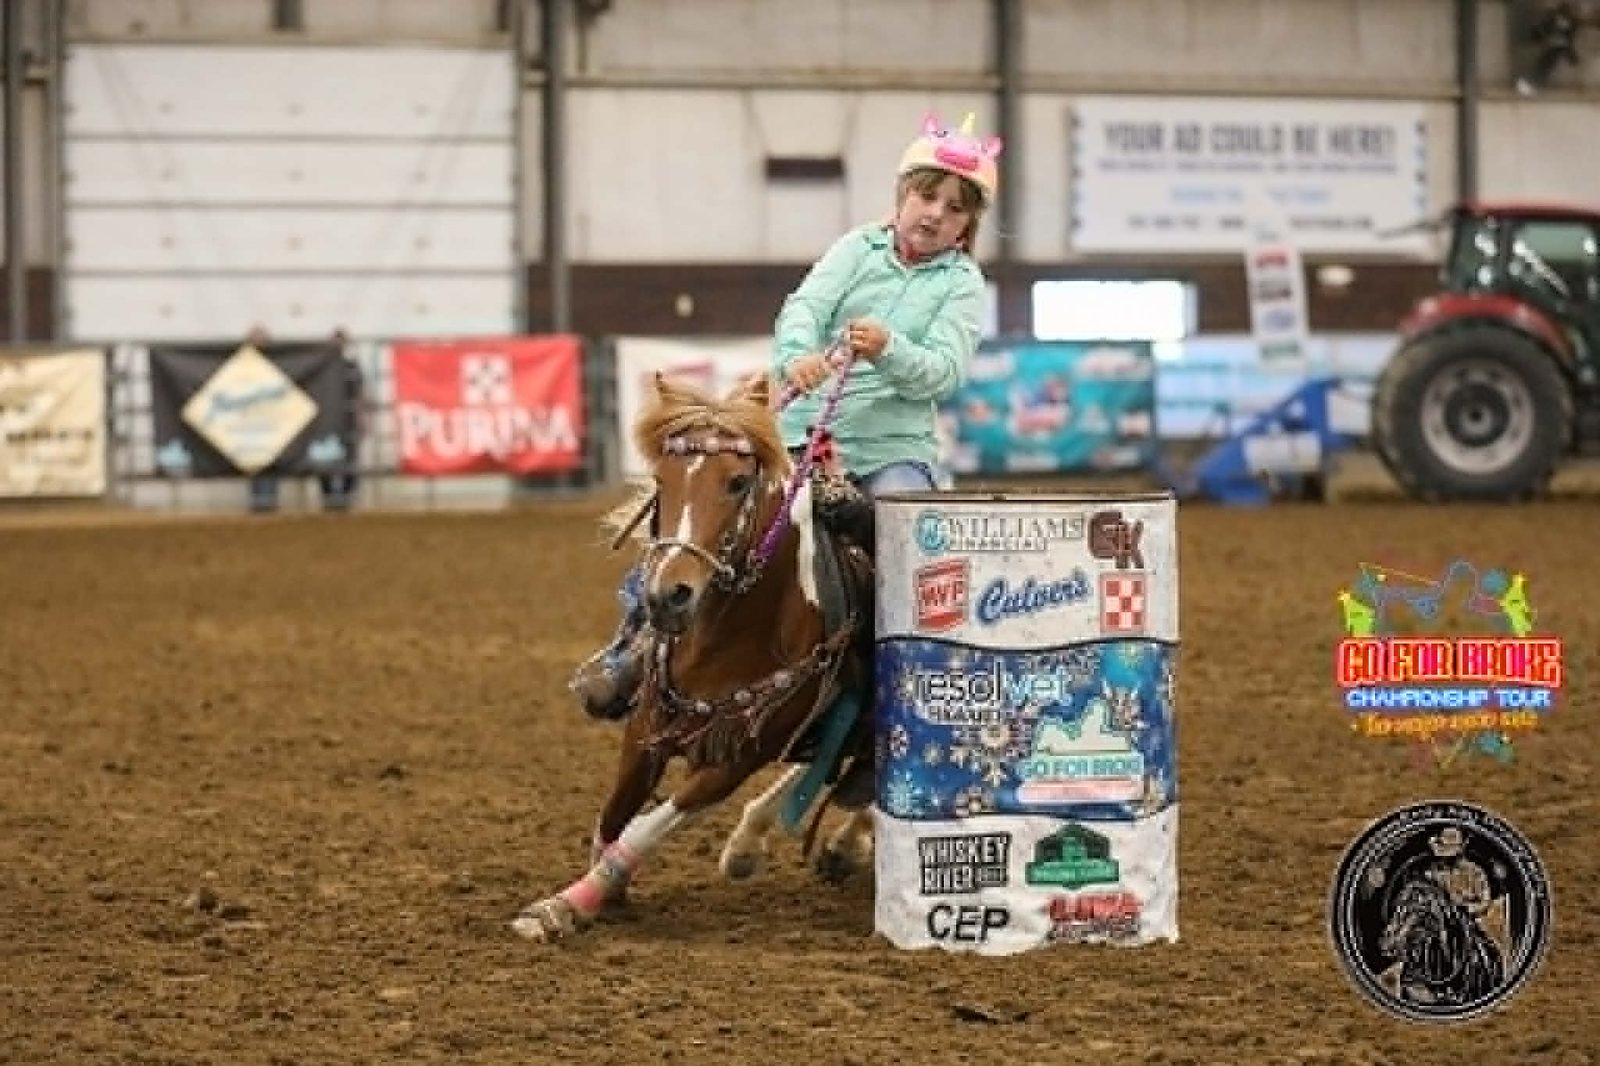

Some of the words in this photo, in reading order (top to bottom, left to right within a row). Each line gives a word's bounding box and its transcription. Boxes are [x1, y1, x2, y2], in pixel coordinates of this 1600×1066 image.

[1104, 121, 1164, 152] YOUR
[1174, 122, 1202, 152] AD
[1211, 122, 1284, 152] COULD
[1294, 123, 1320, 152] BE
[401, 402, 580, 461] PURINA
[946, 513, 1085, 540] WILLIAMS
[977, 567, 1090, 626] Culver's
[920, 835, 1009, 866] WHISKEY
[922, 864, 975, 894] RIVER
[927, 902, 1011, 943] CEP
